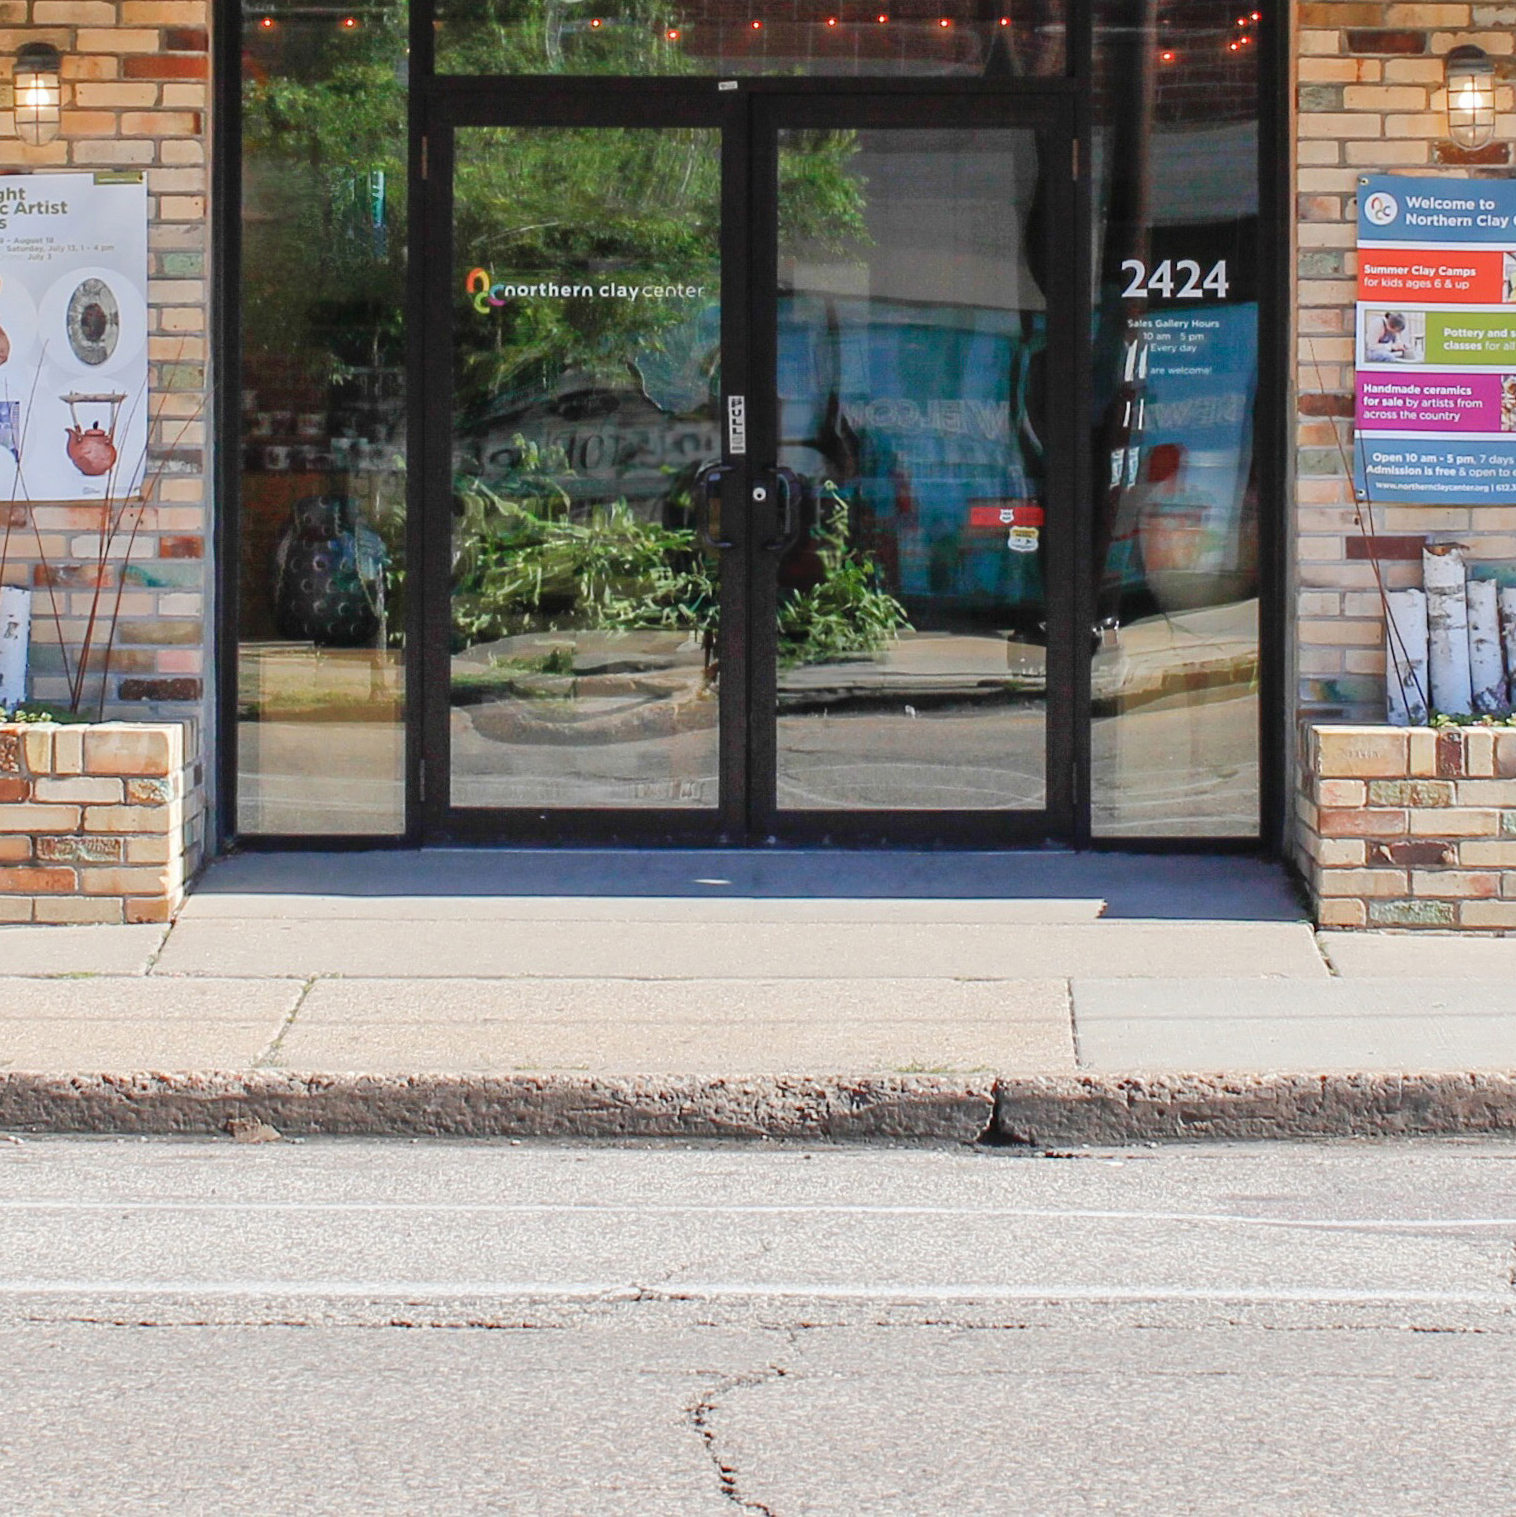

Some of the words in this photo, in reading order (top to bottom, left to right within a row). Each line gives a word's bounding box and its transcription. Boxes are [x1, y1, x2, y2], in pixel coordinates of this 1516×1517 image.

[13, 201, 68, 215] Artist
[1405, 196, 1475, 211] Welcome
[1479, 198, 1495, 211] to
[1405, 213, 1473, 227] Northern
[1476, 214, 1509, 228] Clay
[13, 237, 43, 246] August
[6, 245, 45, 253] Saturday,
[48, 245, 65, 253] July
[101, 245, 115, 253] pm
[28, 254, 44, 262] July
[1120, 258, 1230, 298] 2424
[1363, 265, 1409, 276] Summer
[1411, 265, 1435, 278] Clay
[1438, 266, 1477, 278] Camps
[1363, 277, 1379, 287] for
[1381, 277, 1403, 288] kids
[1405, 280, 1432, 290] ages
[1434, 279, 1442, 289] 6
[1444, 279, 1453, 289] &
[1455, 280, 1470, 290] up
[504, 282, 593, 298] northern
[598, 282, 639, 302] clay
[641, 285, 704, 298] center
[1127, 319, 1153, 328] Sales
[1155, 319, 1189, 330] Gallery
[1191, 319, 1221, 328] Hours
[1143, 332, 1153, 340] 10
[1179, 332, 1186, 341] 5
[1188, 333, 1205, 342] pm
[1443, 327, 1484, 340] Pottery
[1487, 327, 1508, 338] and
[1150, 343, 1177, 353] Every
[1179, 343, 1197, 353] day
[1443, 340, 1483, 351] classes
[1484, 341, 1501, 351] for
[1503, 341, 1516, 351] all
[1150, 367, 1165, 375] are
[1167, 365, 1212, 375] welcome!
[1363, 383, 1421, 395] Handmade
[1423, 384, 1472, 396] ceramics
[1363, 396, 1379, 407] for
[1381, 396, 1404, 407] sale
[1405, 397, 1419, 409] by
[1421, 397, 1455, 408] artists
[1457, 397, 1483, 408] from
[731, 397, 743, 435] PULL
[1363, 410, 1397, 420] across
[1399, 409, 1417, 420] the
[1419, 410, 1461, 422] country
[1372, 452, 1402, 464] Open
[1404, 452, 1418, 463] 10
[1420, 454, 1437, 463] am
[1446, 453, 1454, 464] 5
[1456, 455, 1477, 465] pm,
[1479, 454, 1486, 464] 7
[1488, 454, 1514, 465] days
[1365, 465, 1422, 476] Admission
[1424, 465, 1432, 476] is
[1435, 466, 1456, 477] free
[1459, 466, 1467, 477] &
[1468, 468, 1496, 478] open
[1498, 467, 1510, 477] to
